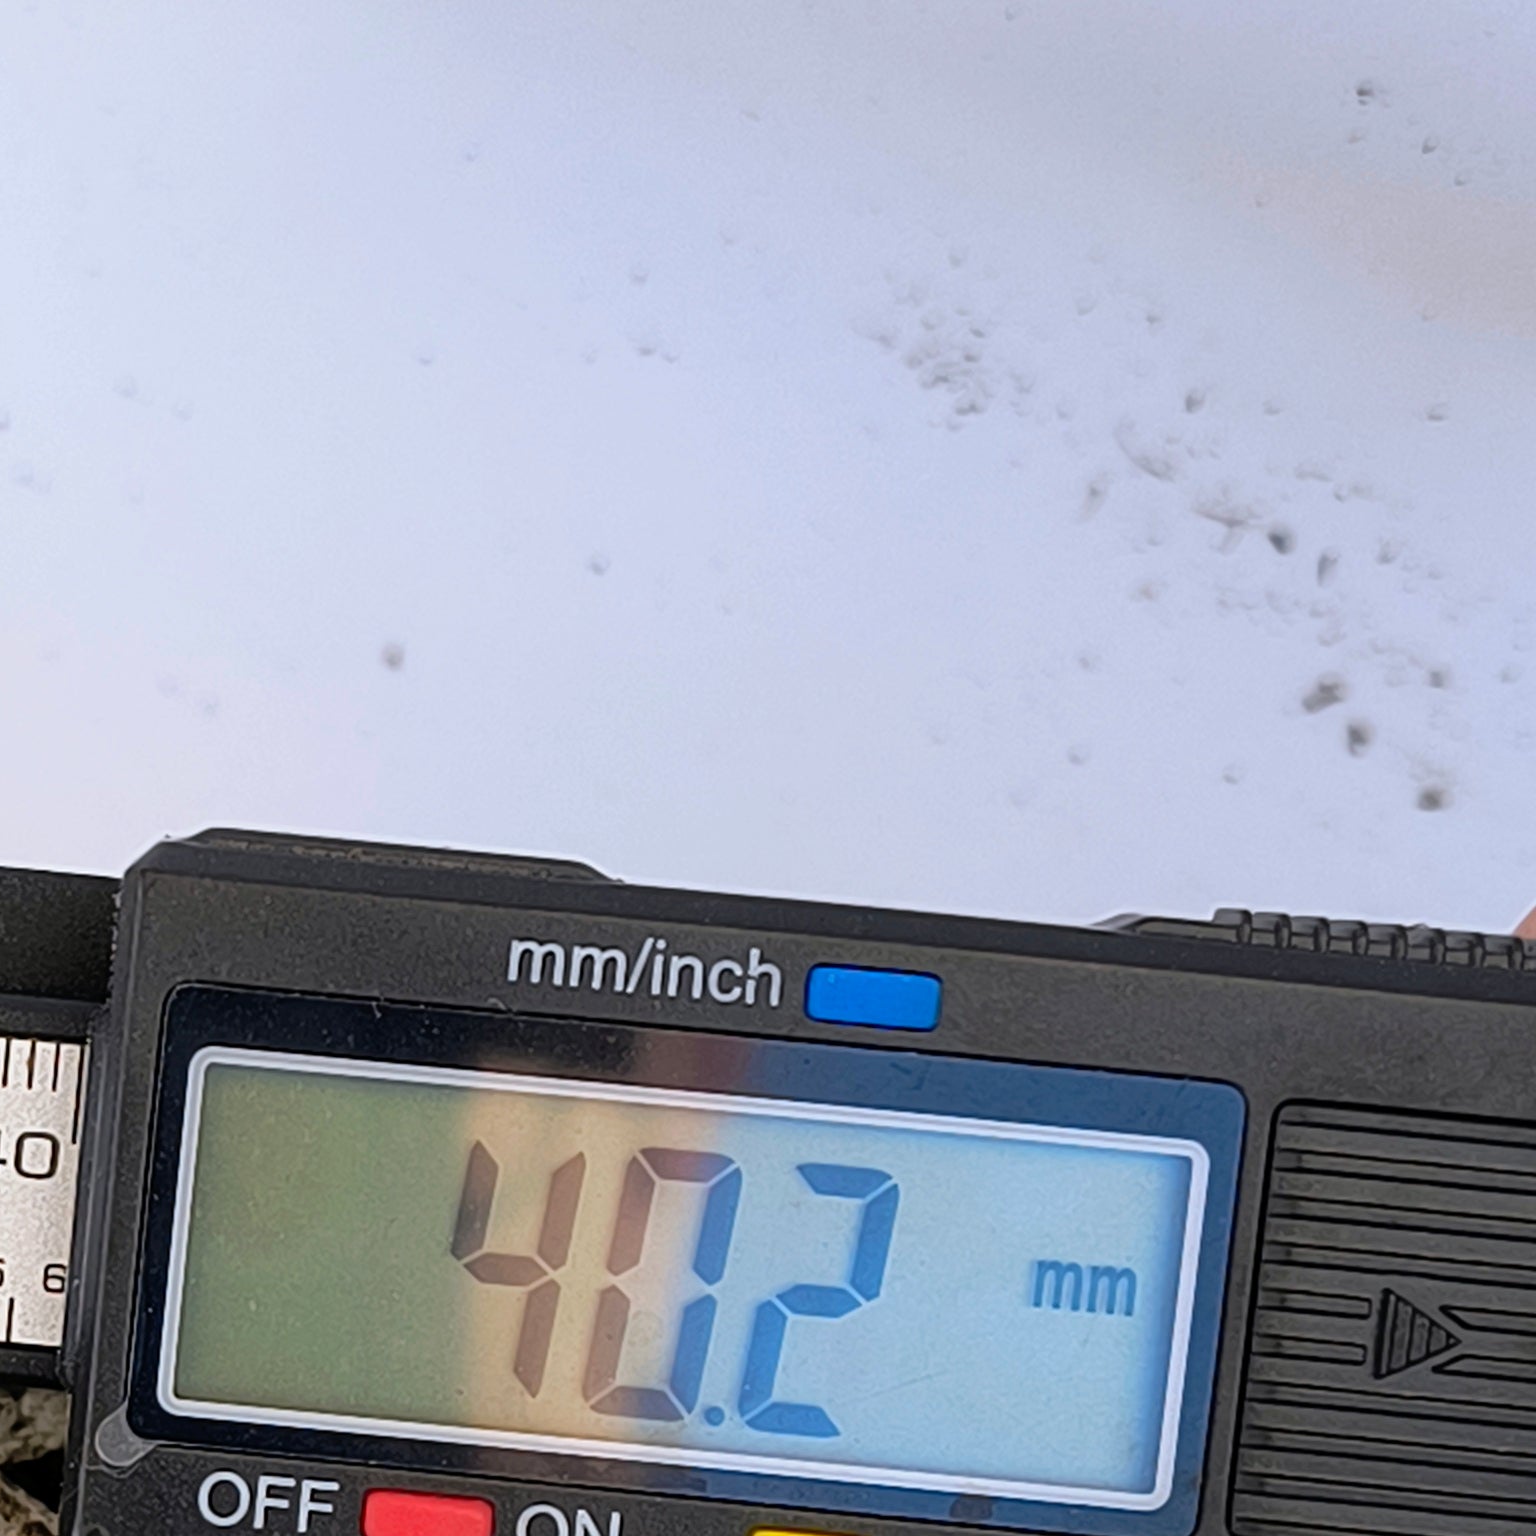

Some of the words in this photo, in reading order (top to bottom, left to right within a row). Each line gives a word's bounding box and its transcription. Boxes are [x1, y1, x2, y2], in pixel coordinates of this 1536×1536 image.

[507, 936, 783, 1007] mm/inch
[43, 1263, 65, 1293] 6
[449, 1139, 899, 1438] 40.2
[1030, 1256, 1138, 1319] mm
[197, 1471, 339, 1536] OFF
